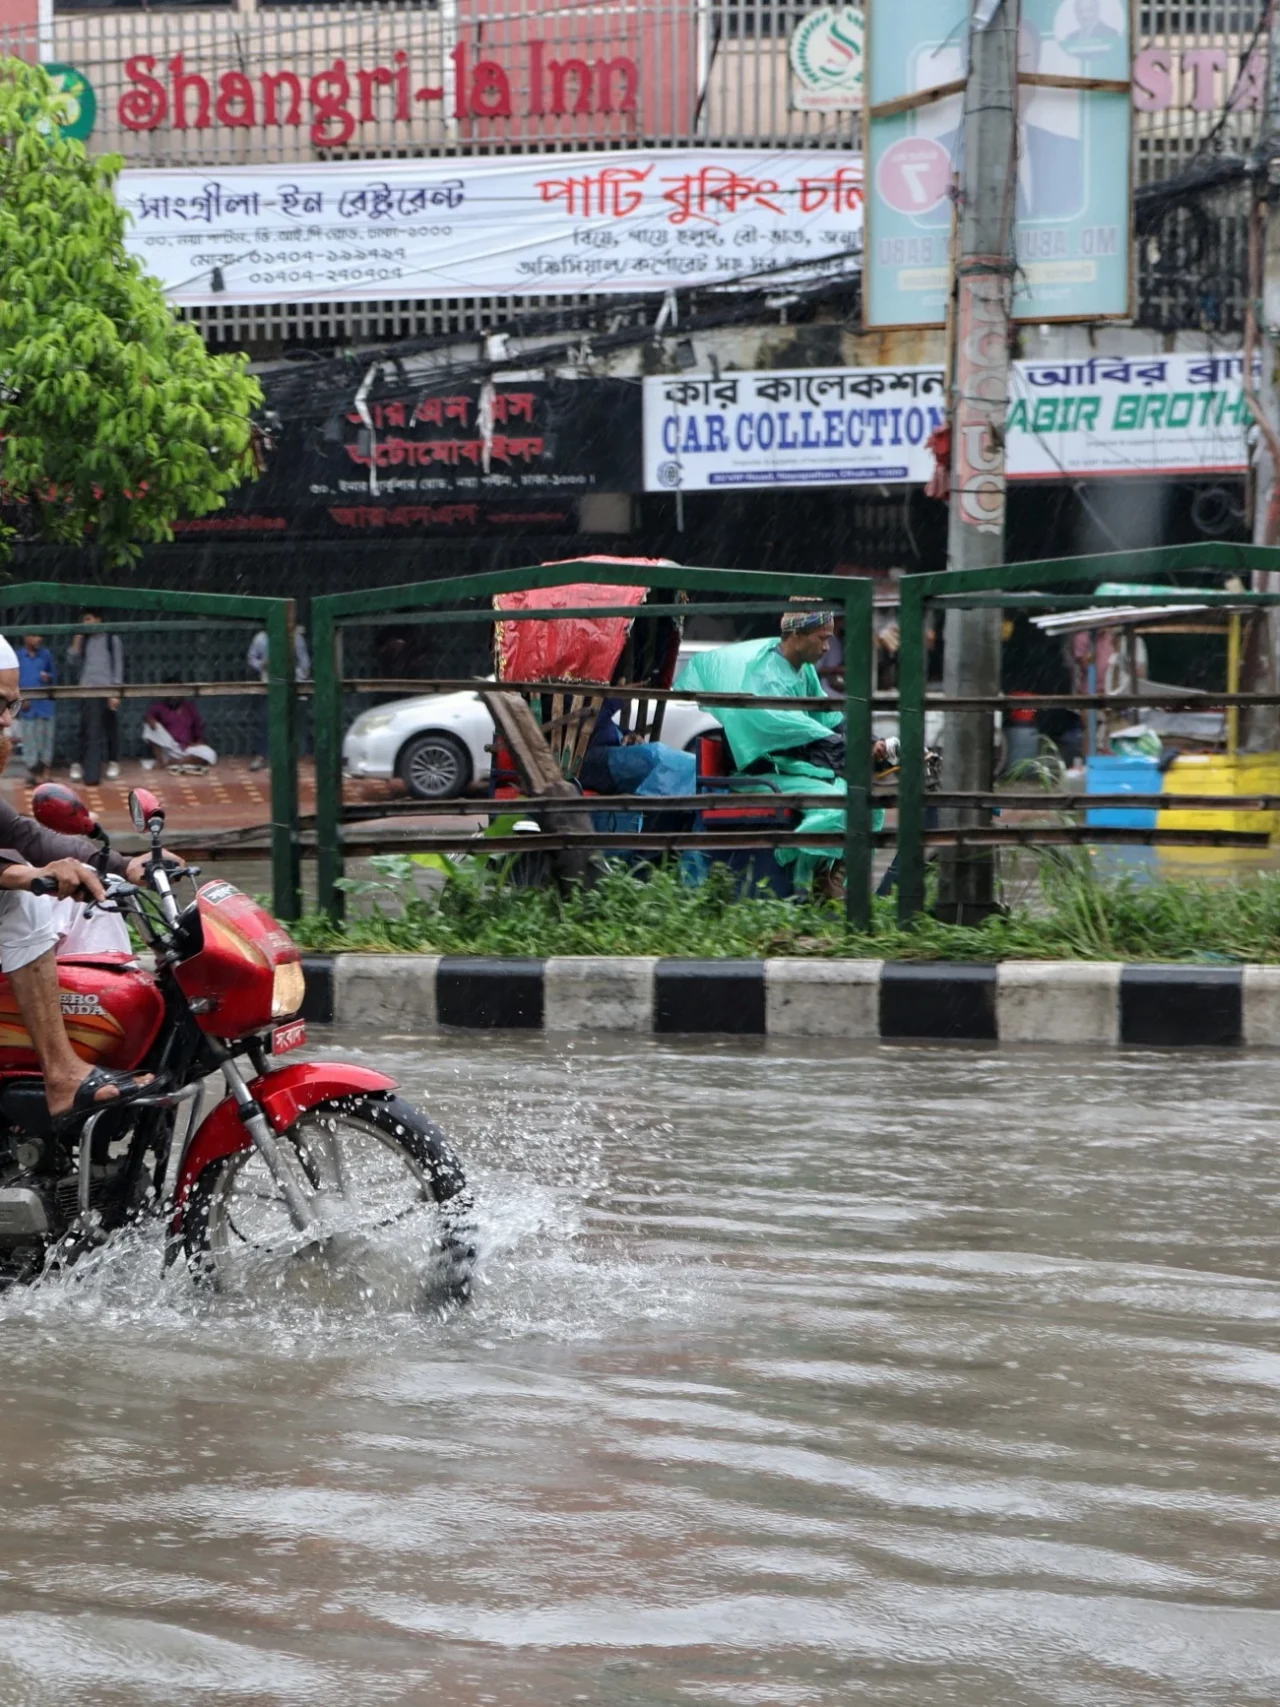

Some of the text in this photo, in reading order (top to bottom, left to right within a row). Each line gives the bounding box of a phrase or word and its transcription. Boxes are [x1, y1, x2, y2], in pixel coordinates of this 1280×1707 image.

[119, 40, 638, 147] Shangri-la Inn
[535, 164, 655, 218] পার্টি
[660, 167, 786, 227] বুকিং
[663, 371, 945, 410] কার কালেকশন
[1025, 356, 1170, 387] আবির
[662, 413, 730, 455] CAR
[1006, 396, 1102, 434] ABIR
[59, 993, 100, 1005] ERO
[61, 1004, 108, 1016] NDA
